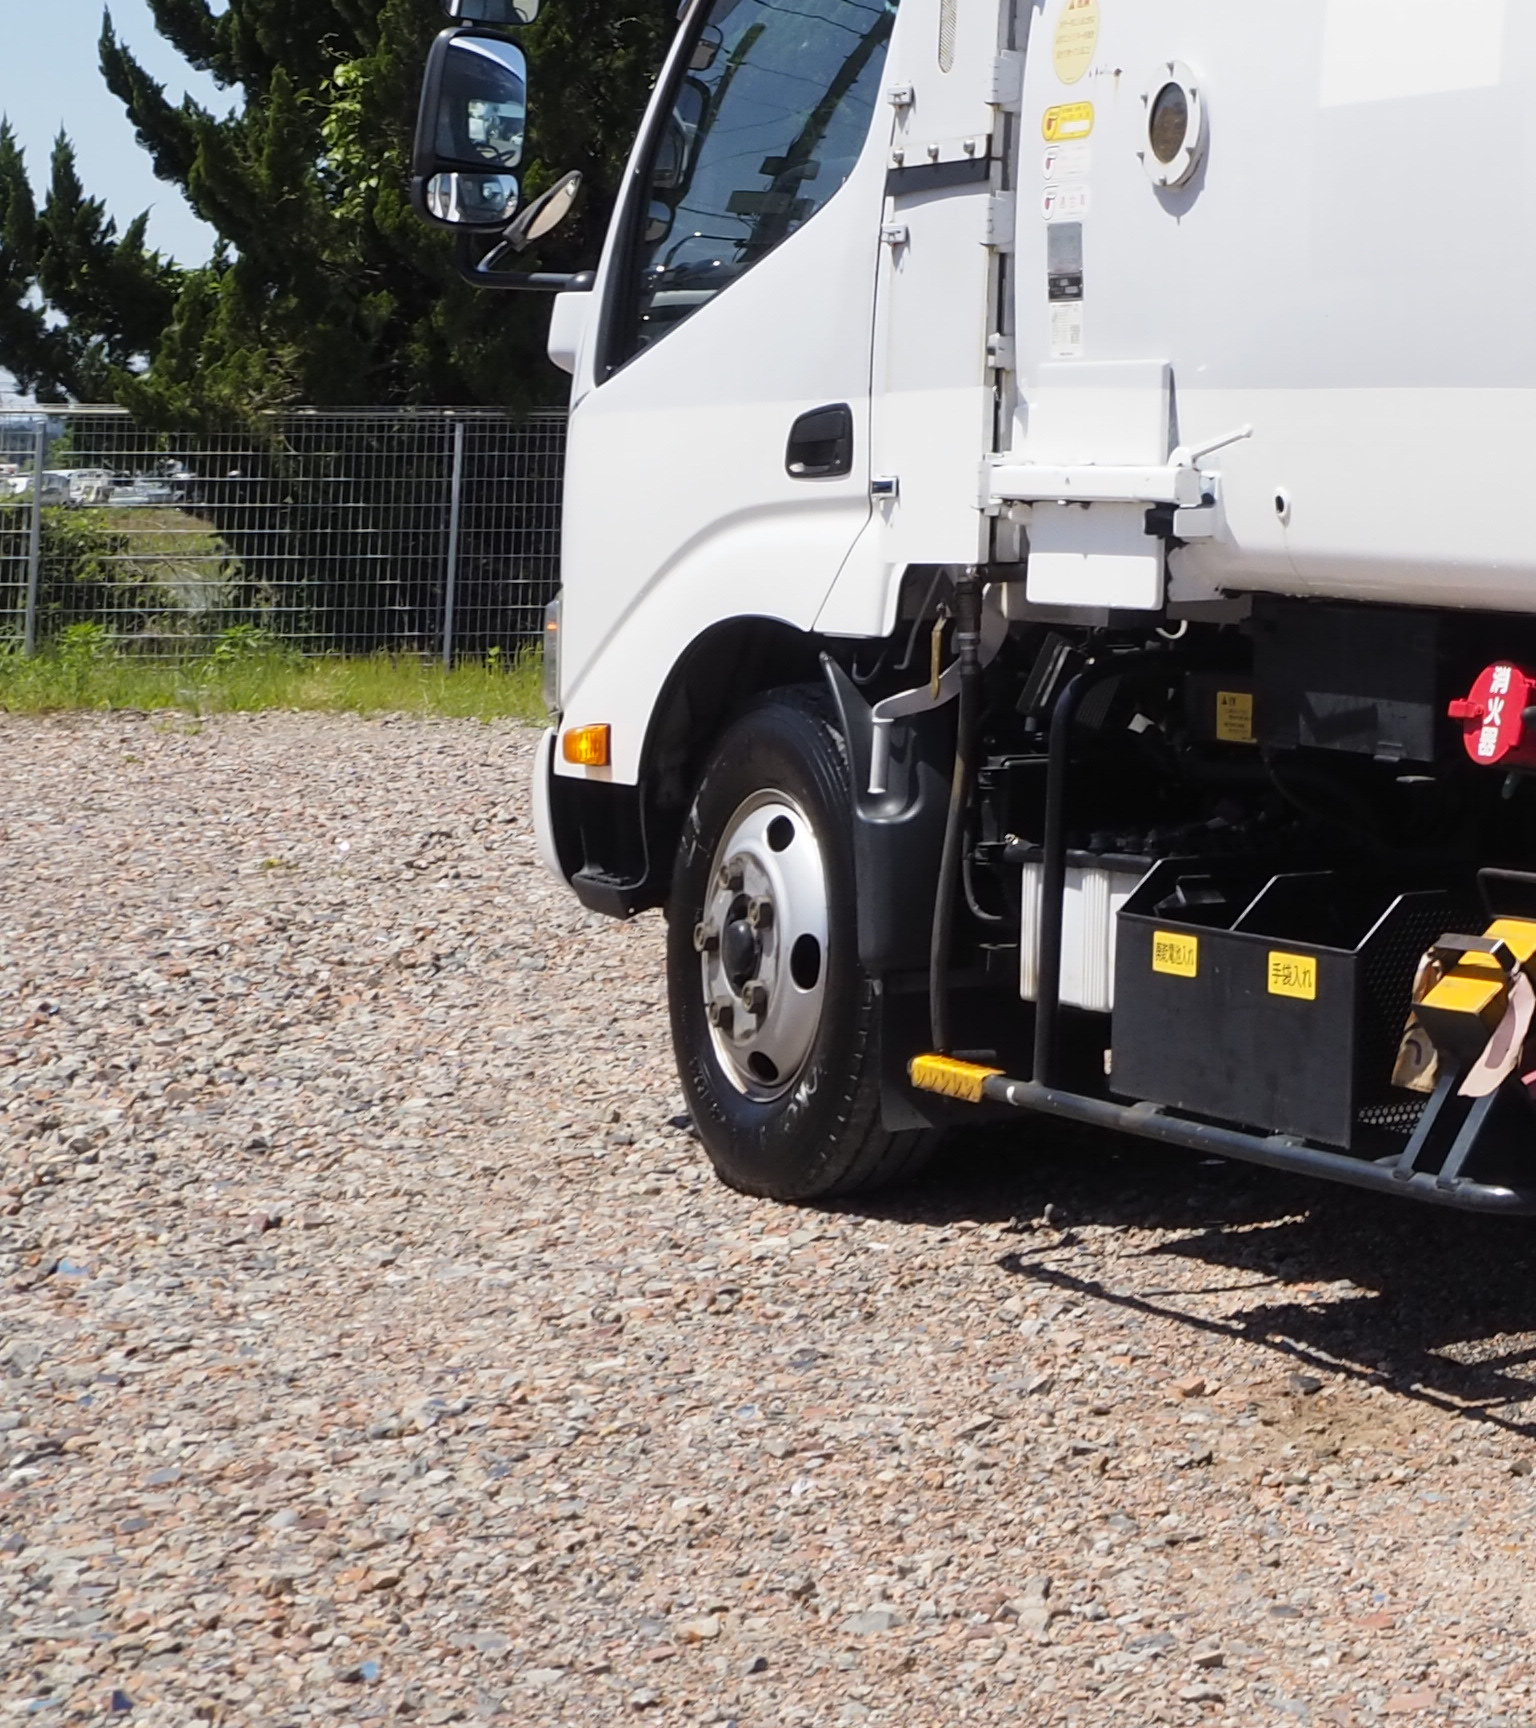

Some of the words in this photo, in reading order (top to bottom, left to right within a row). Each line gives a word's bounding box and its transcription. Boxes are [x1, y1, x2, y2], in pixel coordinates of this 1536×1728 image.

[1477, 665, 1512, 757] 消火器
[1271, 962, 1312, 989] 手袋入れ
